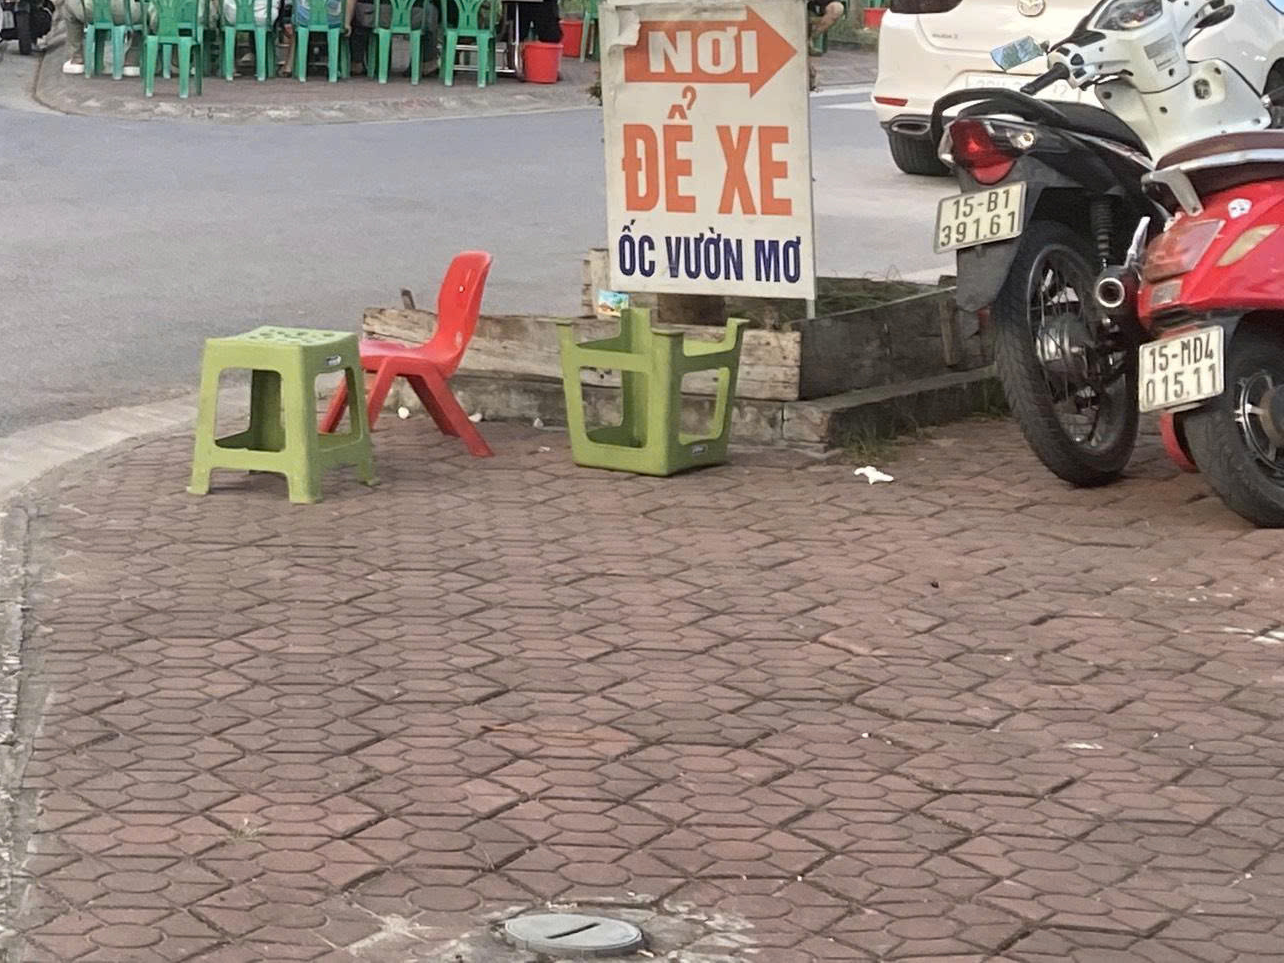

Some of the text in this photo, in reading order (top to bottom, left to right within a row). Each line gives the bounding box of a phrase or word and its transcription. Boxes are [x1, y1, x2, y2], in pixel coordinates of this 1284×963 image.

[648, 26, 759, 75] NƠI
[621, 85, 793, 216] ĐỂ XE
[952, 188, 1010, 220] 15-B1
[618, 219, 802, 283] ỐC VƯỜN MƠ
[940, 210, 1016, 247] 391.61
[1146, 363, 1216, 404] 015.11
